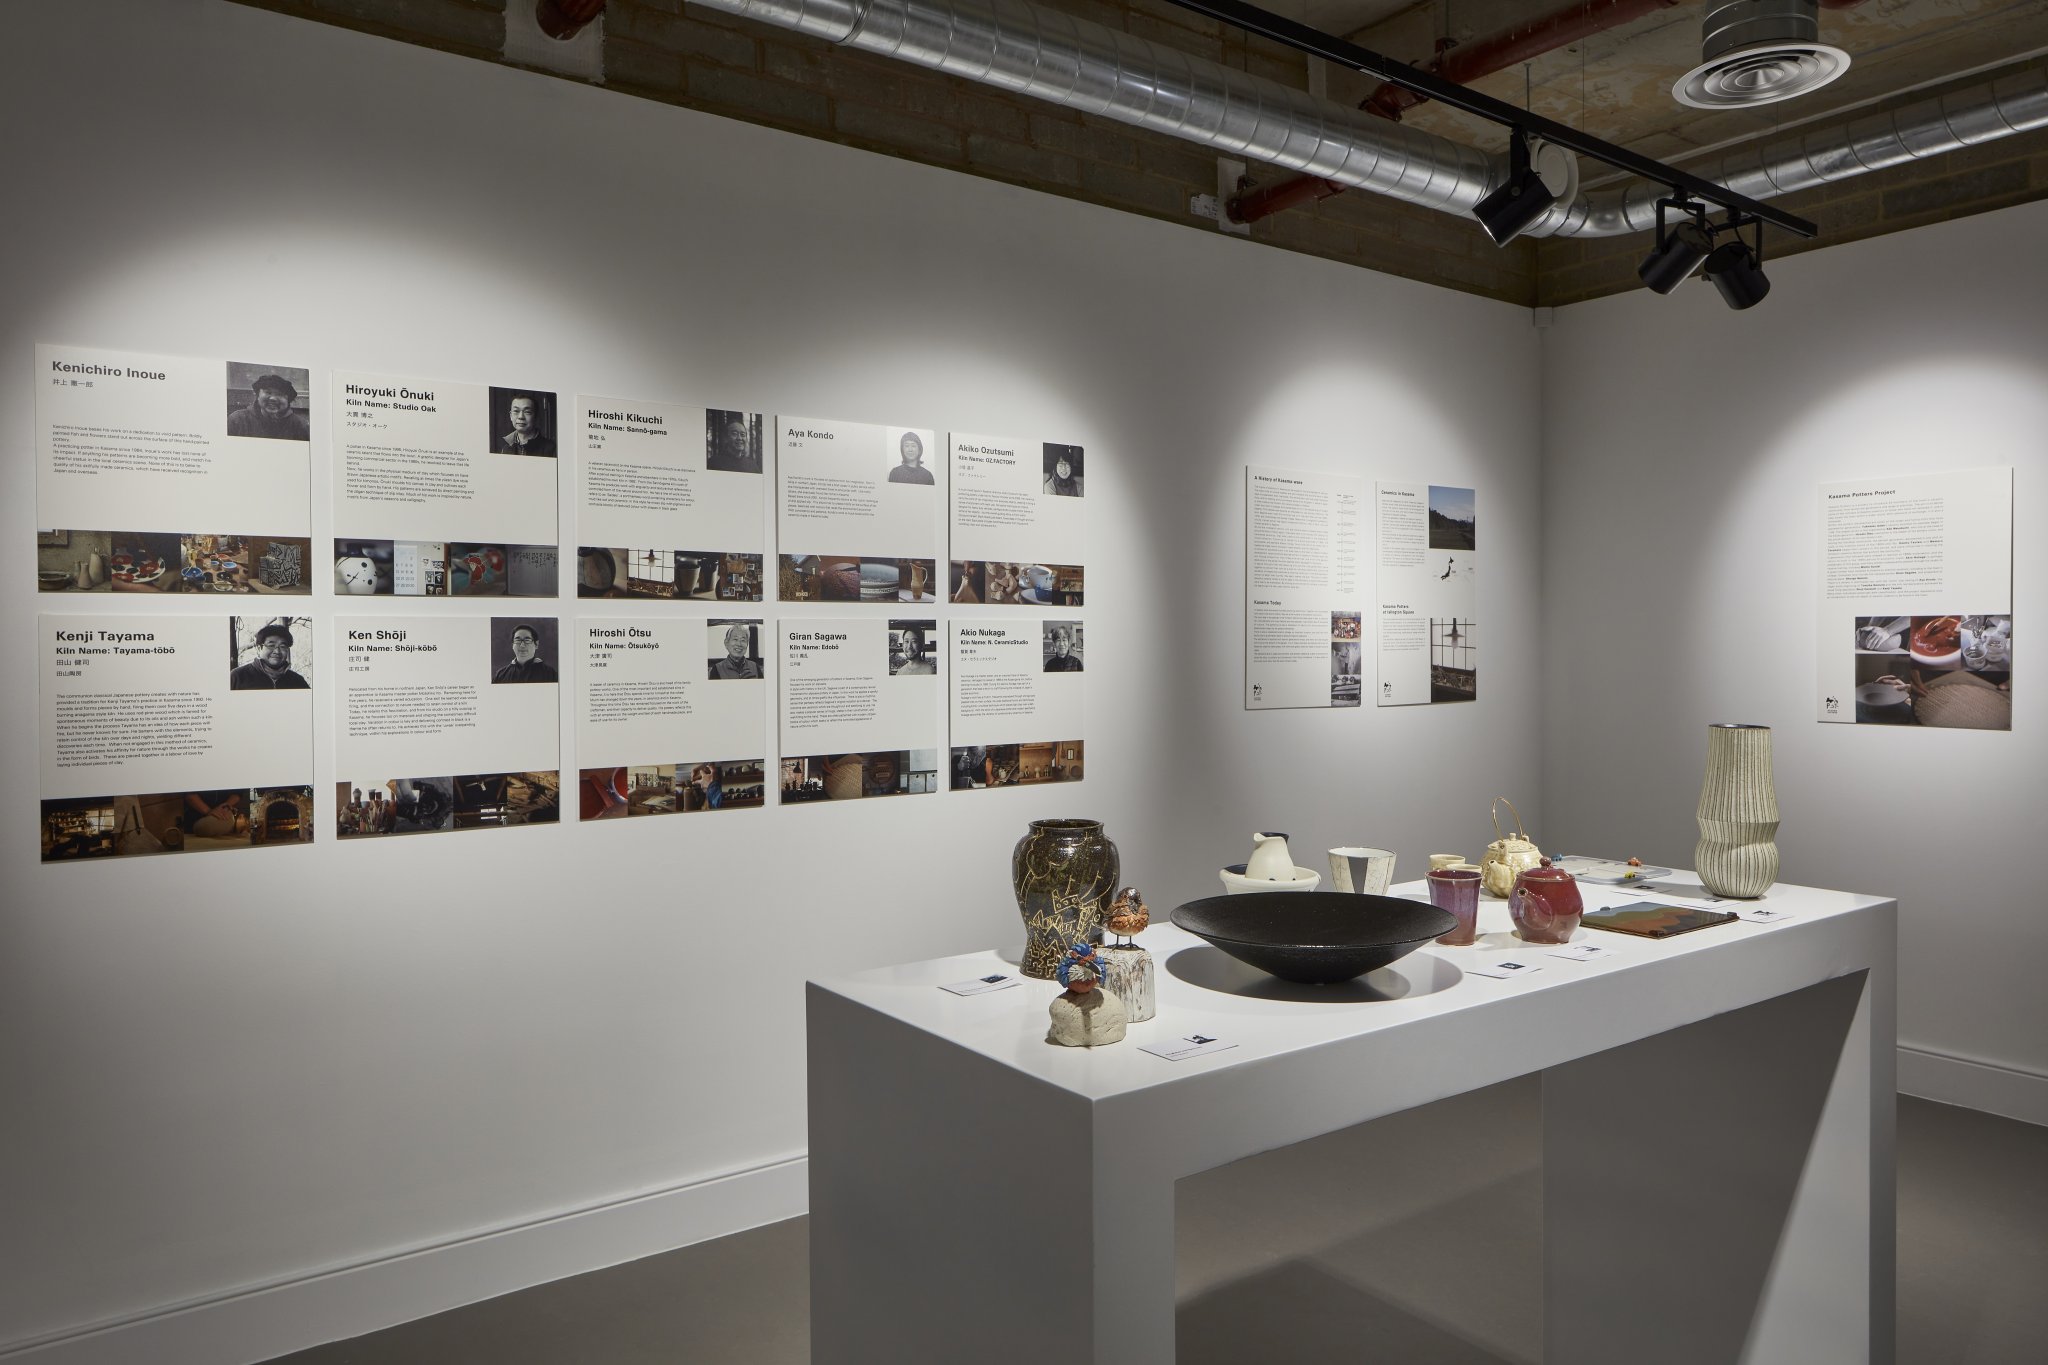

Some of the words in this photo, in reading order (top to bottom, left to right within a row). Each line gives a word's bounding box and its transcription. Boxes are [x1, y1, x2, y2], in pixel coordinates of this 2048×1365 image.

[53, 361, 121, 376] Kenichiro
[127, 368, 166, 380] Inoue
[346, 384, 396, 397] Hiroyuki
[400, 388, 434, 400] Ōnuki
[364, 400, 390, 408] Name:
[393, 403, 419, 411] Studio
[588, 410, 623, 420] Hiroshi
[627, 414, 662, 424] Kikuchi
[788, 429, 804, 438] Aya
[807, 430, 834, 439] Kondo
[958, 444, 978, 453] Akiko
[981, 447, 1014, 456] Ozutsumi
[1875, 489, 1895, 497] Project
[56, 631, 93, 643] Kenji
[98, 631, 154, 643] Tayama
[349, 631, 372, 639] Ken
[376, 630, 406, 641] Shōji
[590, 629, 625, 637] Hiroshi
[629, 626, 651, 637] Ōtsu
[814, 633, 847, 641] Sagawa
[979, 629, 1005, 637] Nukaga
[114, 646, 175, 655] Tayama-tōbō
